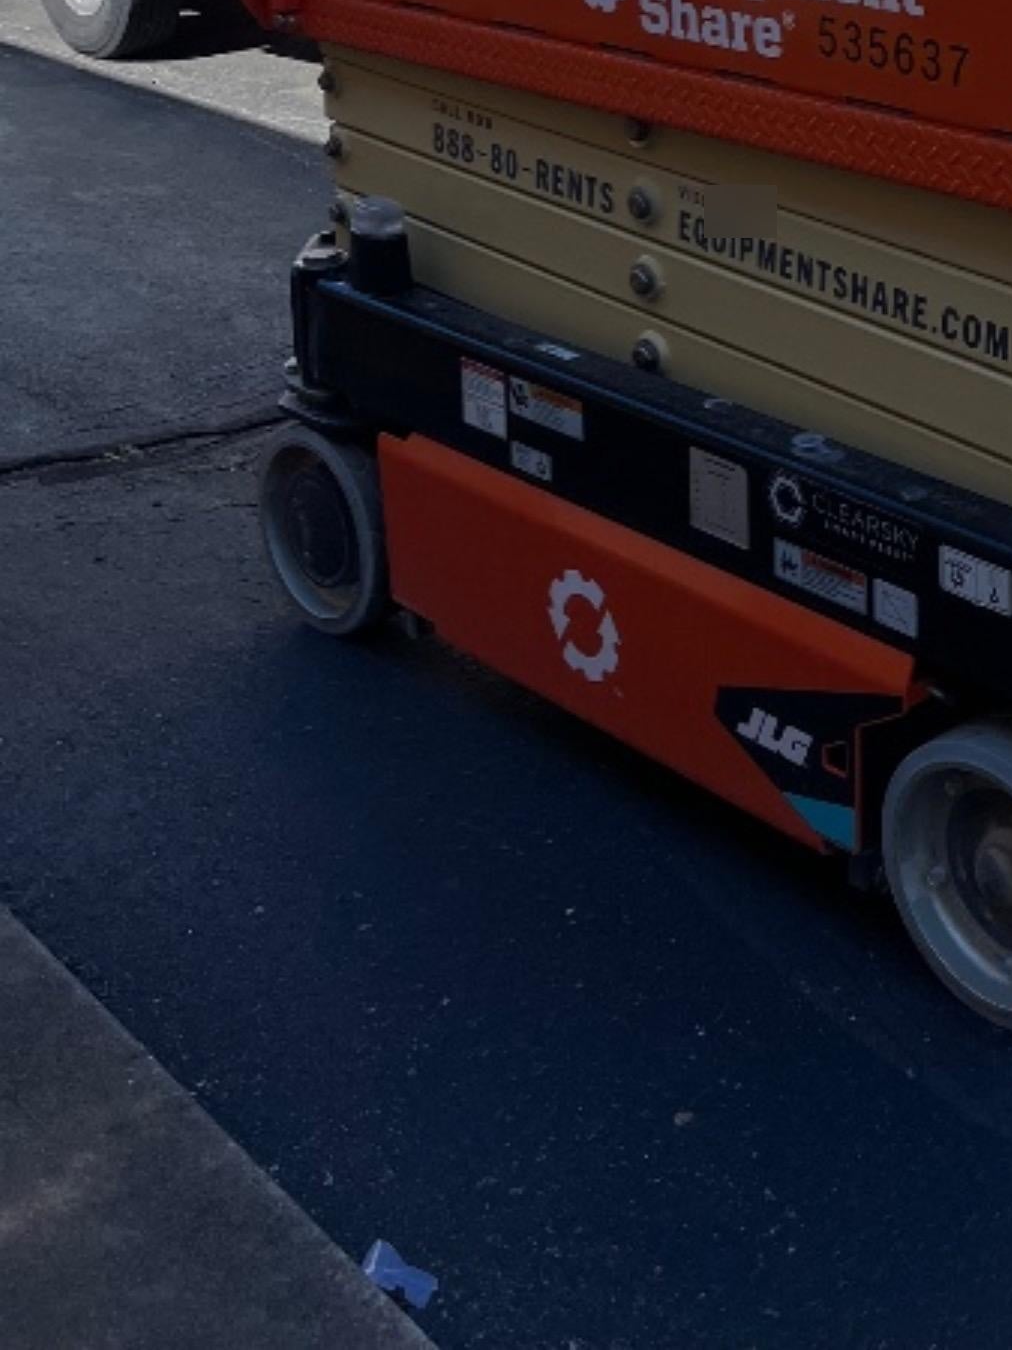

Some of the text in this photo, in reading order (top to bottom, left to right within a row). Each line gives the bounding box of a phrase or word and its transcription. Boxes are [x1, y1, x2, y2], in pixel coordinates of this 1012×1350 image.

[818, 15, 970, 87] 535637
[432, 122, 614, 214] 888-80-RENTS
[736, 706, 814, 767] JLG
